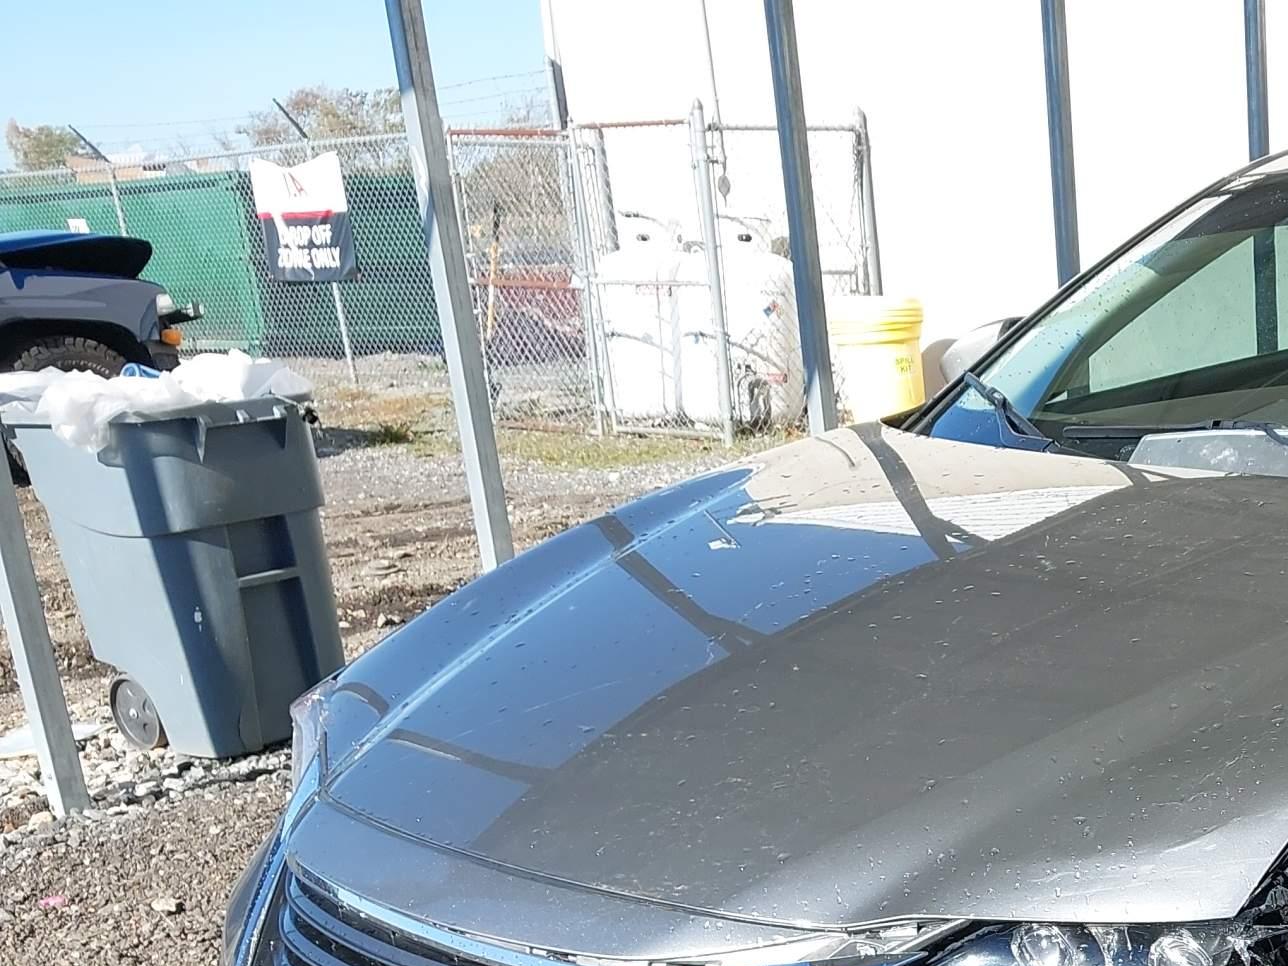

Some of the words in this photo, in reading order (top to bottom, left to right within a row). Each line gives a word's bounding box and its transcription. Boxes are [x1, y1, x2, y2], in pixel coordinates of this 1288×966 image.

[280, 226, 311, 246] DROP
[312, 224, 332, 245] OFF
[278, 247, 311, 269] ZONE
[311, 246, 340, 268] ONLY
